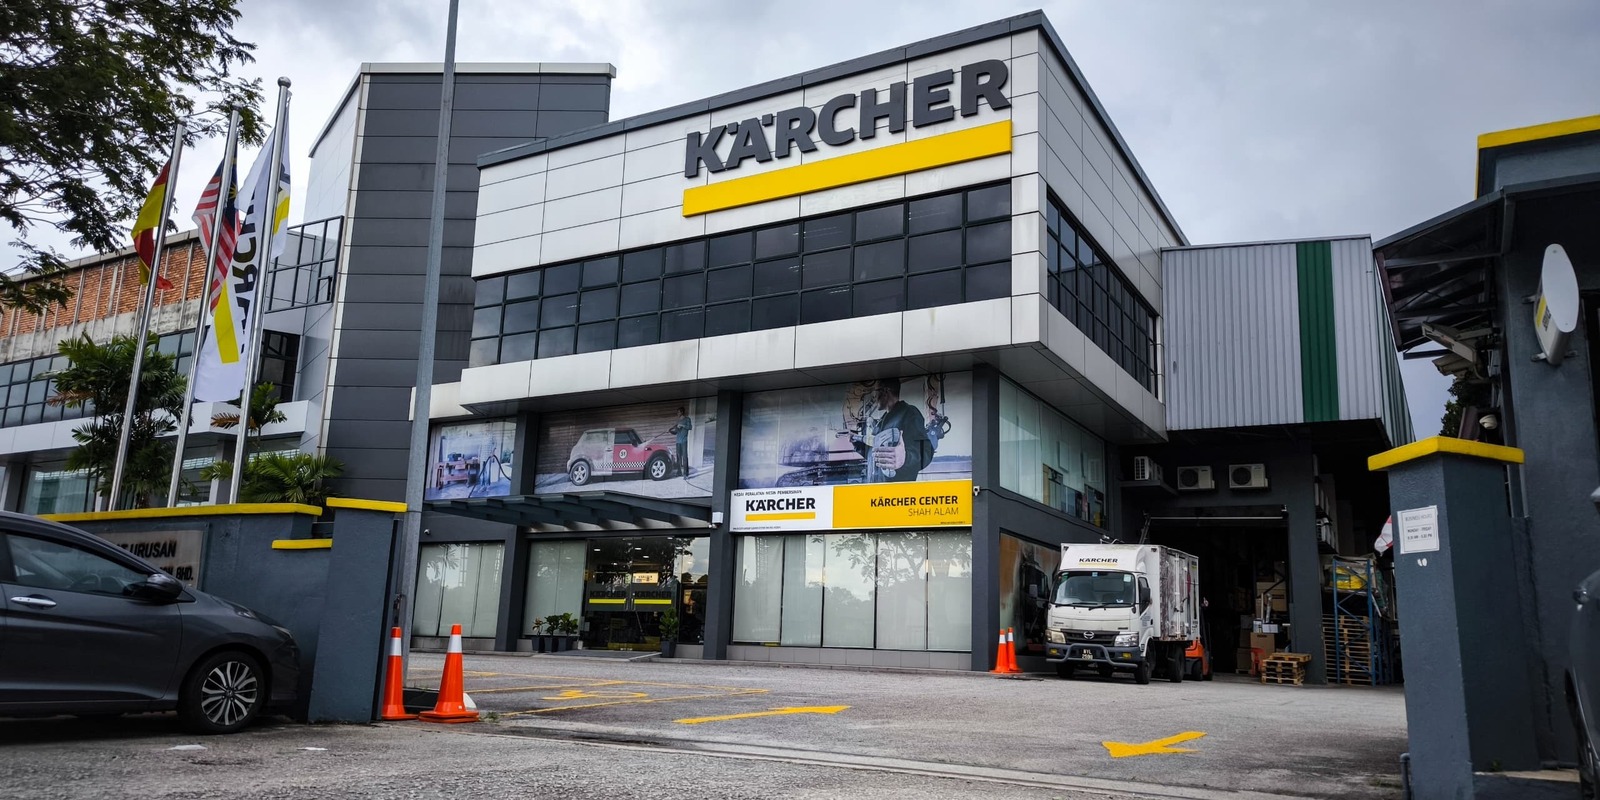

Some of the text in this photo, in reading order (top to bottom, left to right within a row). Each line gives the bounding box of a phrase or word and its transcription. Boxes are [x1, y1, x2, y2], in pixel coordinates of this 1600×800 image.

[684, 58, 1012, 179] KÄRCHER
[745, 497, 816, 512] KÄRCHER
[870, 495, 958, 507] KÄRCHER CENTER
[908, 507, 959, 517] SHAH ALAM
[130, 541, 177, 558] URUSAN
